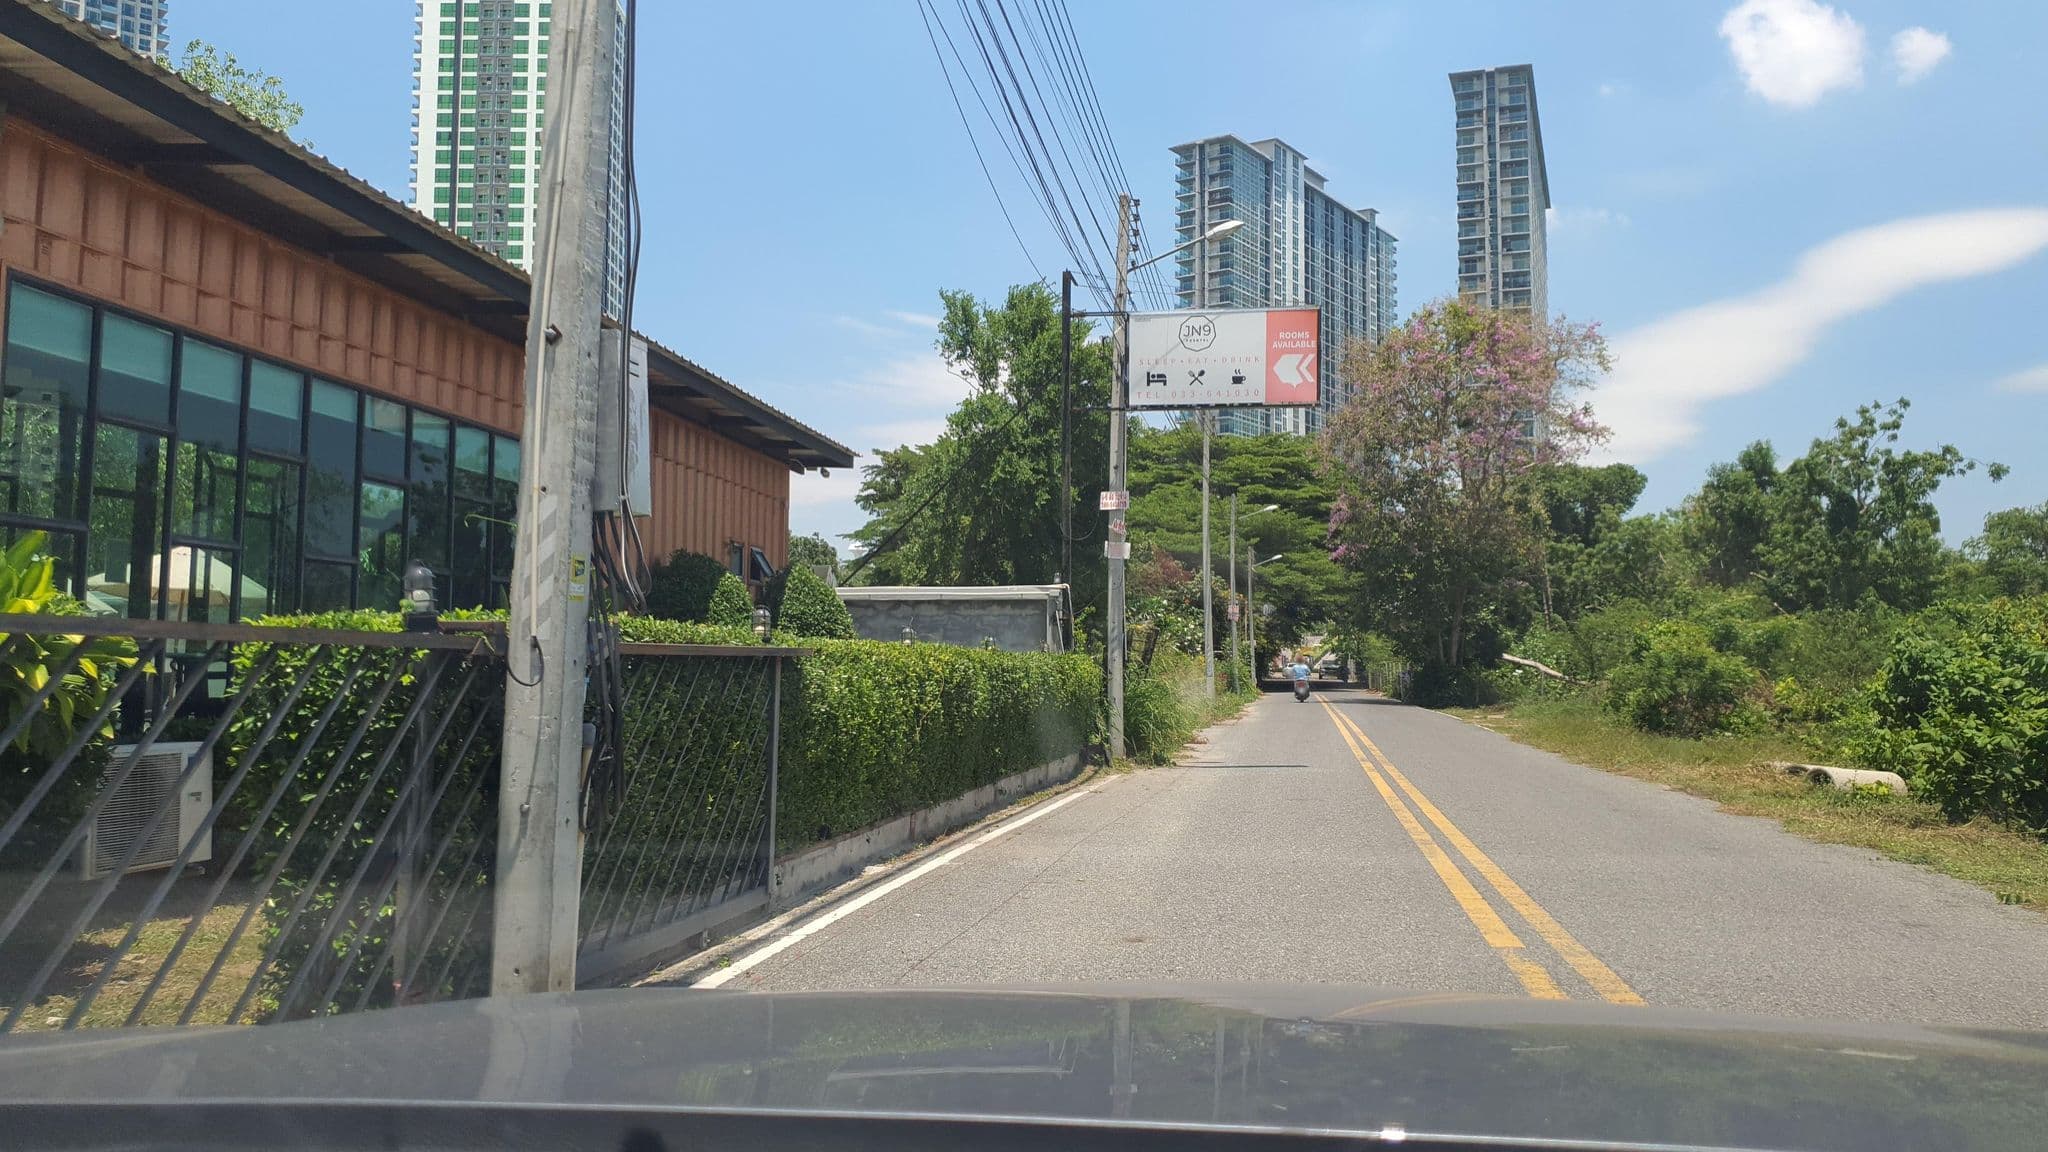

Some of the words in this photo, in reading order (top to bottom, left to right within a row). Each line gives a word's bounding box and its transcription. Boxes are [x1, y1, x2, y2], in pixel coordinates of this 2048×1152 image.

[1183, 324, 1211, 337] JN9
[1279, 331, 1310, 339] ROOMS
[1272, 340, 1316, 349] AVAILABLE
[1221, 355, 1261, 364] DRINK
